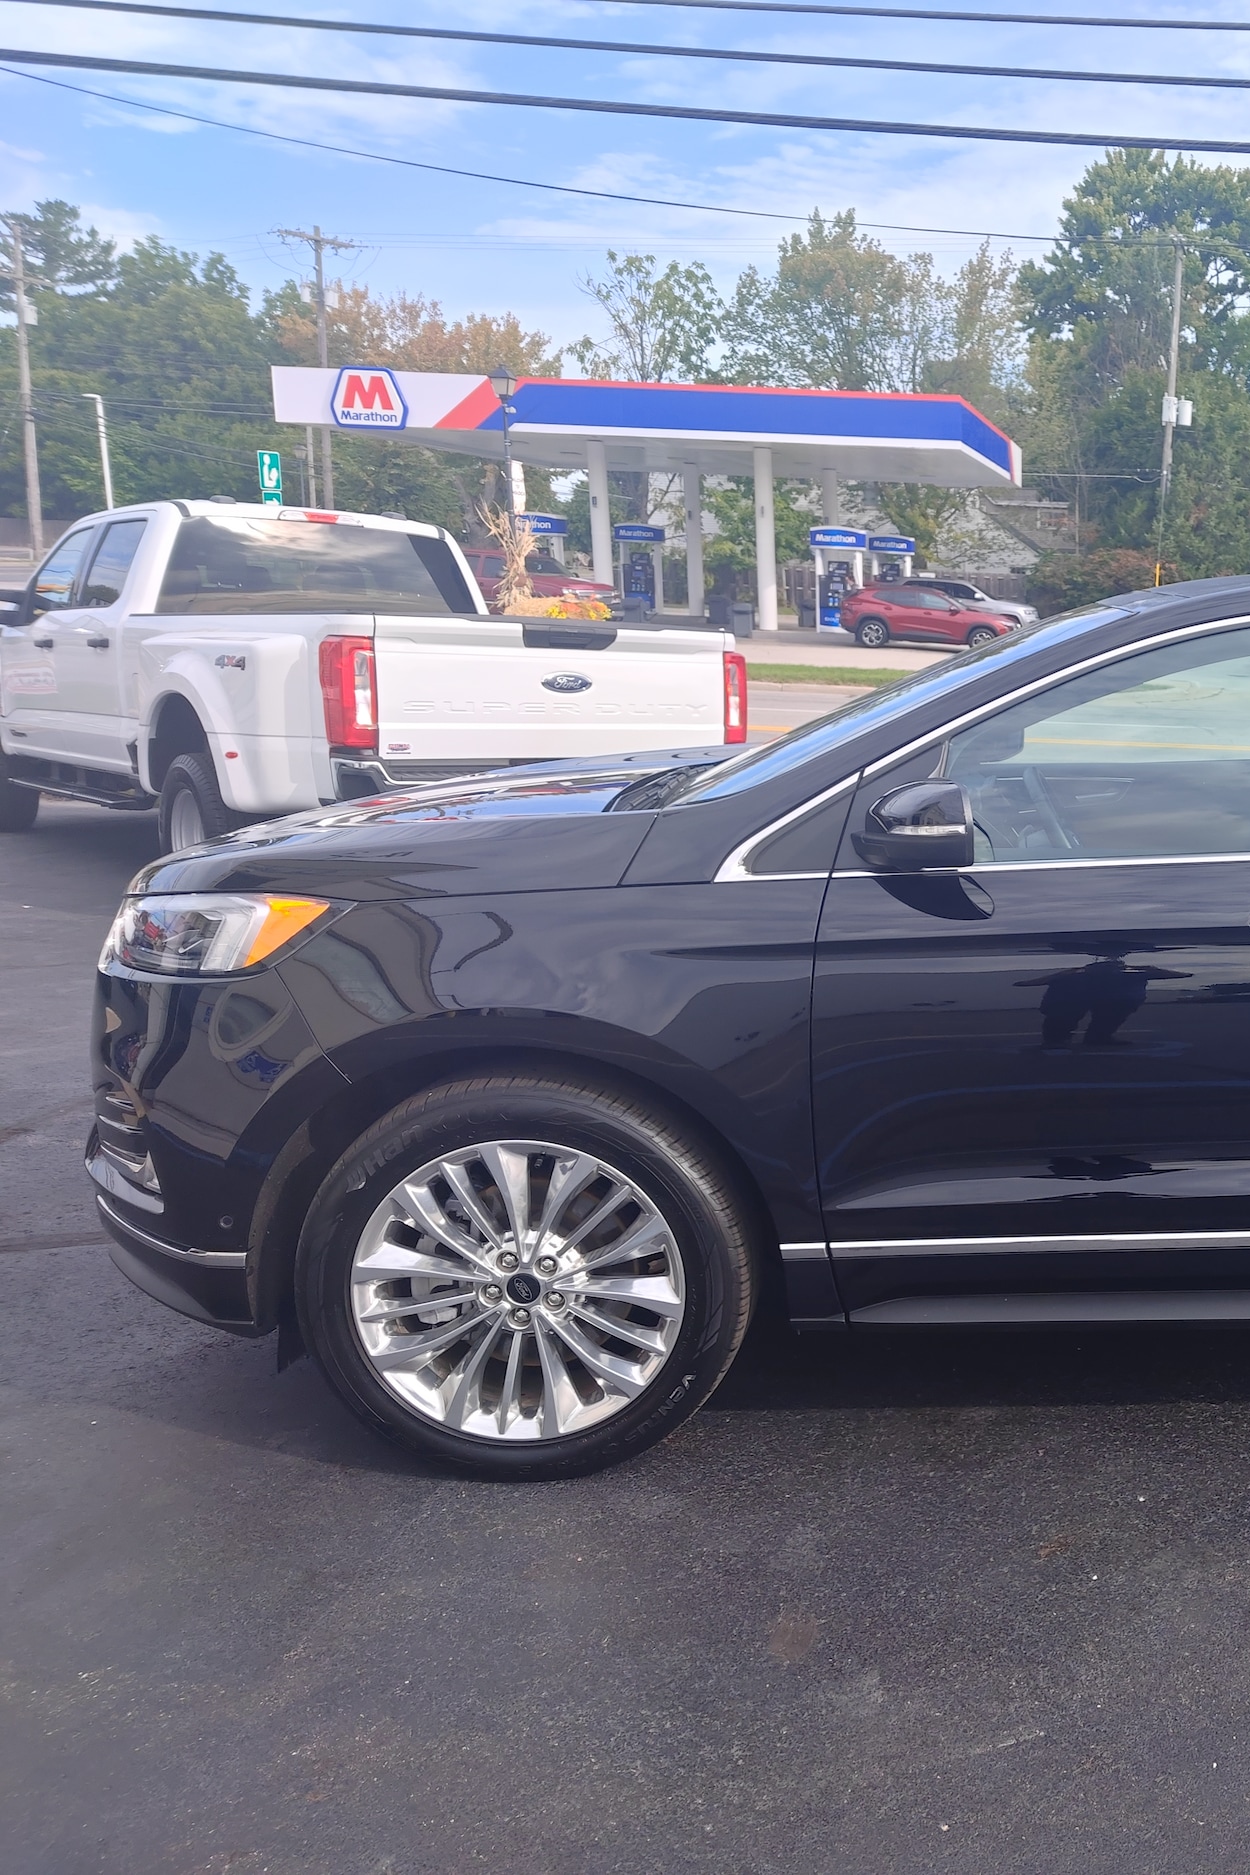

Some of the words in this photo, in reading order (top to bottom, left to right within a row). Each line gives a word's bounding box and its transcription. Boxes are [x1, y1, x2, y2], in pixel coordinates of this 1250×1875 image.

[342, 374, 394, 410] M
[341, 410, 397, 423] Marathon
[618, 529, 654, 538] Marathon
[815, 533, 856, 544] Marathon
[872, 540, 908, 549] Marathon
[554, 676, 582, 689] Ford
[403, 700, 580, 716] SUPER
[595, 702, 708, 718] DUTY
